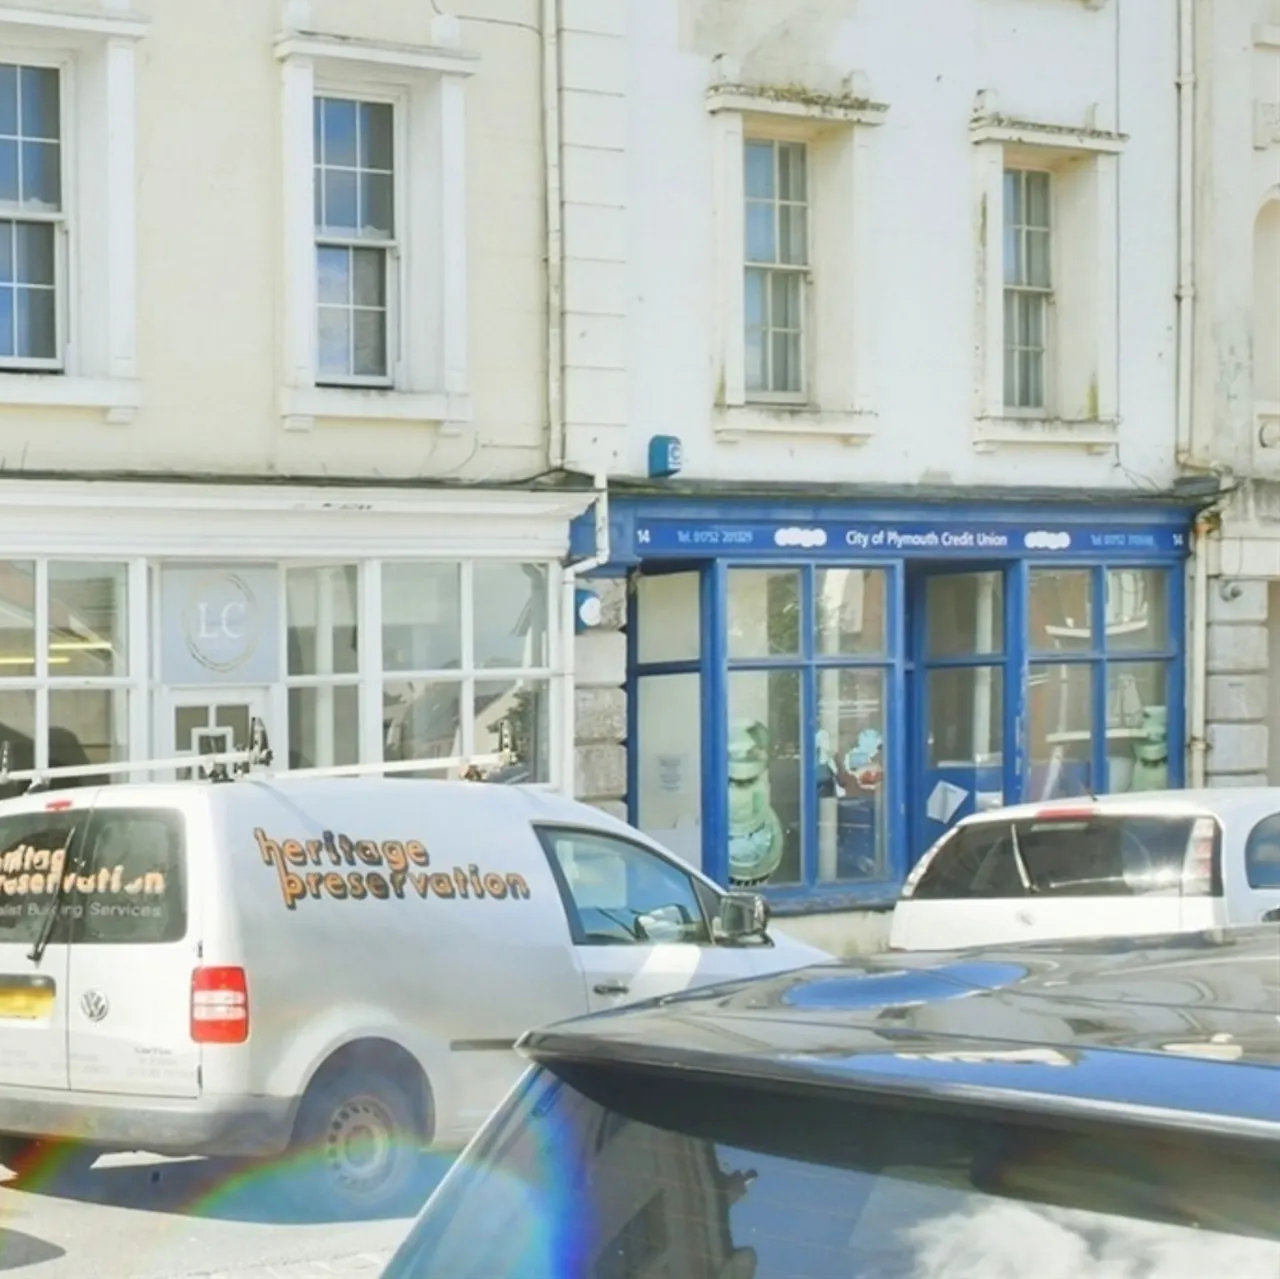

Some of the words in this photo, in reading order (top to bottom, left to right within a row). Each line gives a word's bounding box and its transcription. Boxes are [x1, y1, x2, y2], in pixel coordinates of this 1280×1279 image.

[636, 528, 651, 544] 14
[845, 530, 869, 549] City
[872, 530, 885, 545] of
[887, 531, 939, 549] Plymouth
[941, 531, 974, 547] Credit
[977, 532, 1008, 547] Union
[196, 601, 245, 639] LC
[253, 827, 430, 871] heritage
[278, 864, 531, 910] preservation
[90, 901, 163, 918] Services
